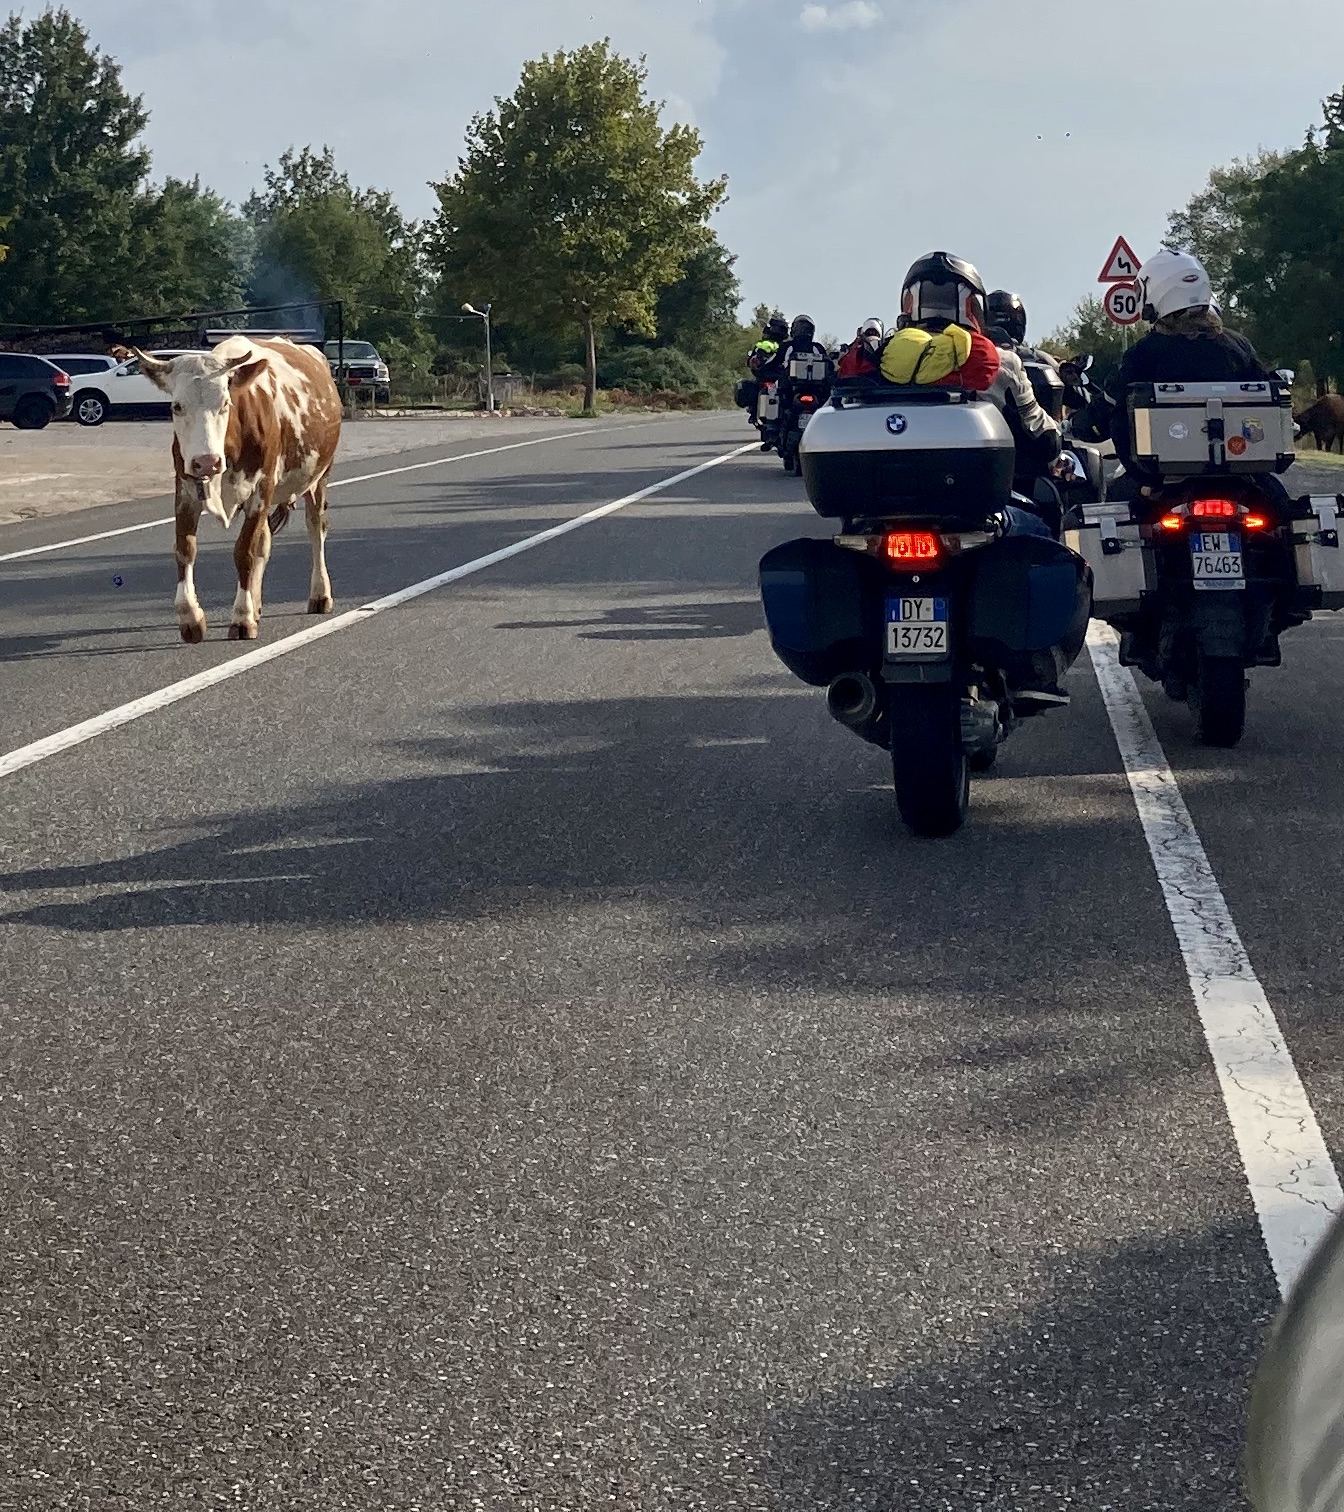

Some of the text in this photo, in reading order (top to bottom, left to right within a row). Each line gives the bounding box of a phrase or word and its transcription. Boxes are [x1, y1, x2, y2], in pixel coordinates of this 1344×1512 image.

[1113, 294, 1136, 315] 50
[1194, 556, 1241, 575] 76463
[902, 599, 923, 620] DY
[892, 627, 944, 649] 13732
